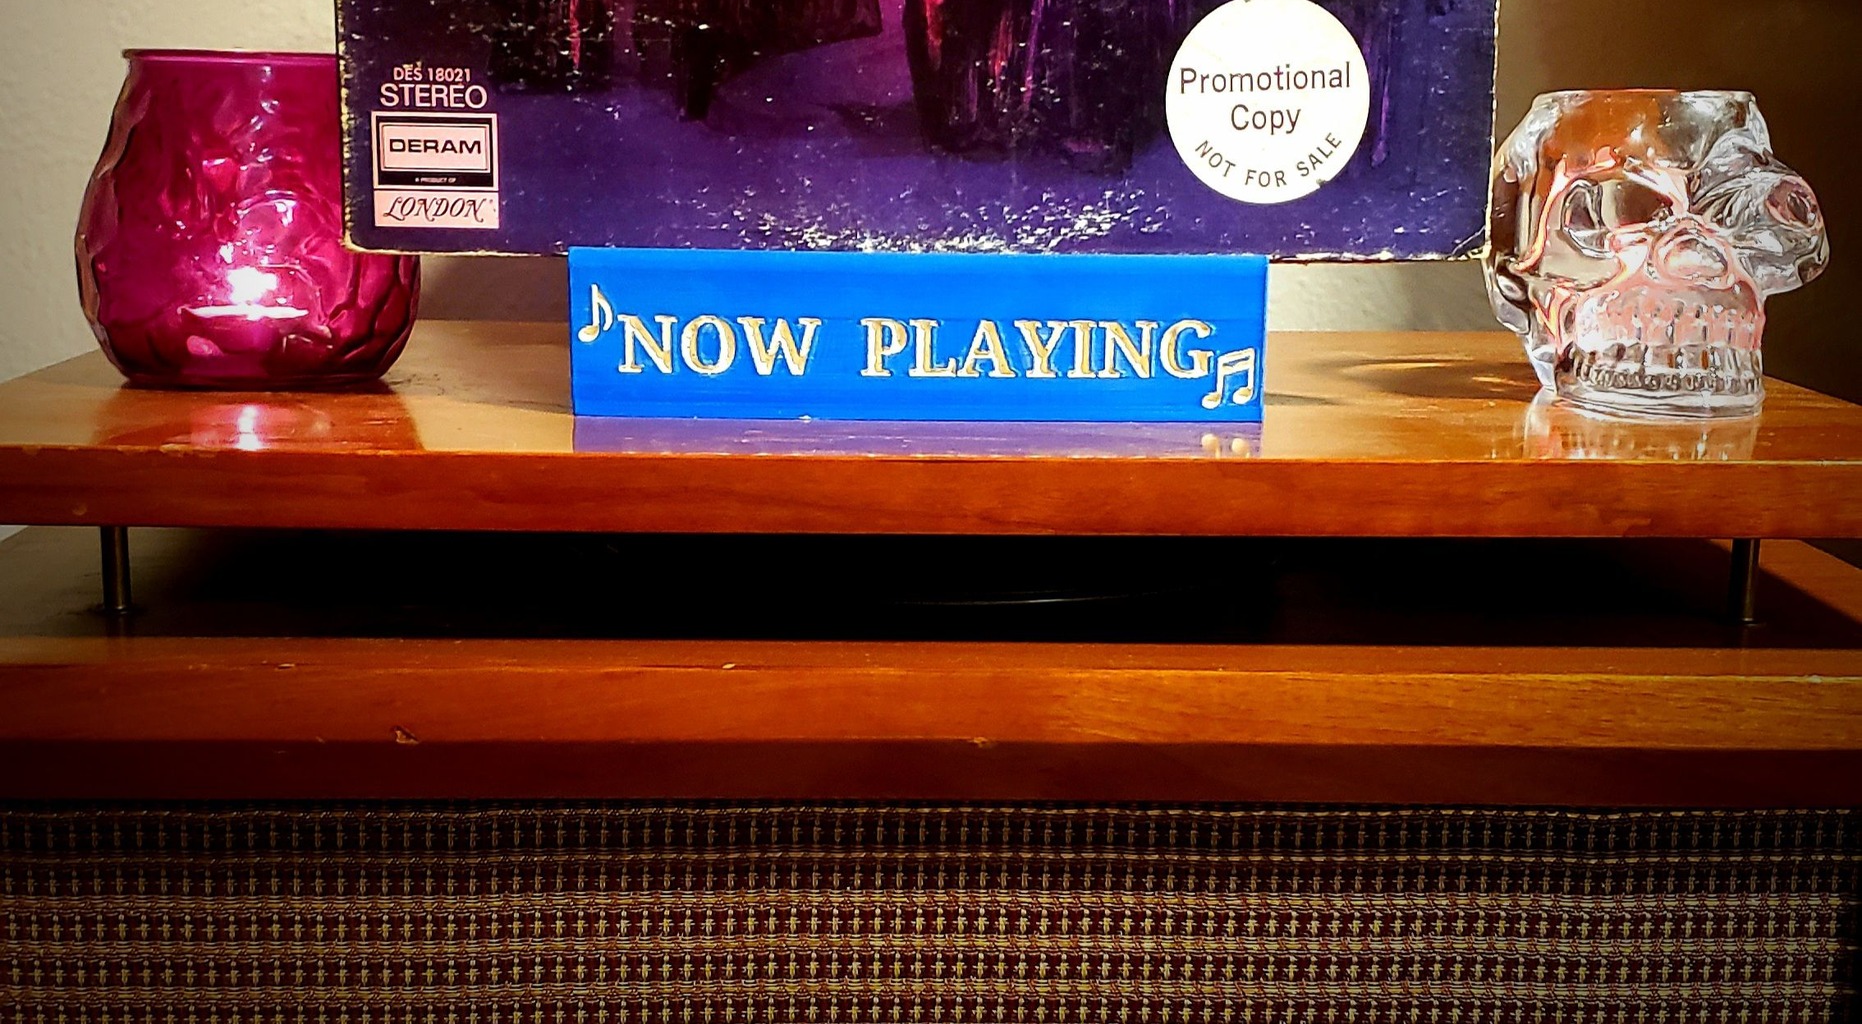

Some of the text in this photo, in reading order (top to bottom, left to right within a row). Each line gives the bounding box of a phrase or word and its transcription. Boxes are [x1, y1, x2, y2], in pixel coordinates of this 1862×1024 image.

[393, 66, 471, 83] DES 18021
[1180, 61, 1351, 94] Promotional
[379, 83, 488, 109] STEREO
[1230, 103, 1302, 136] Copy
[389, 138, 481, 154] DERAM
[1195, 132, 1342, 188] NOT FOR SALE
[383, 196, 485, 223] LONDON
[616, 313, 1216, 380] NOW PLAYING
